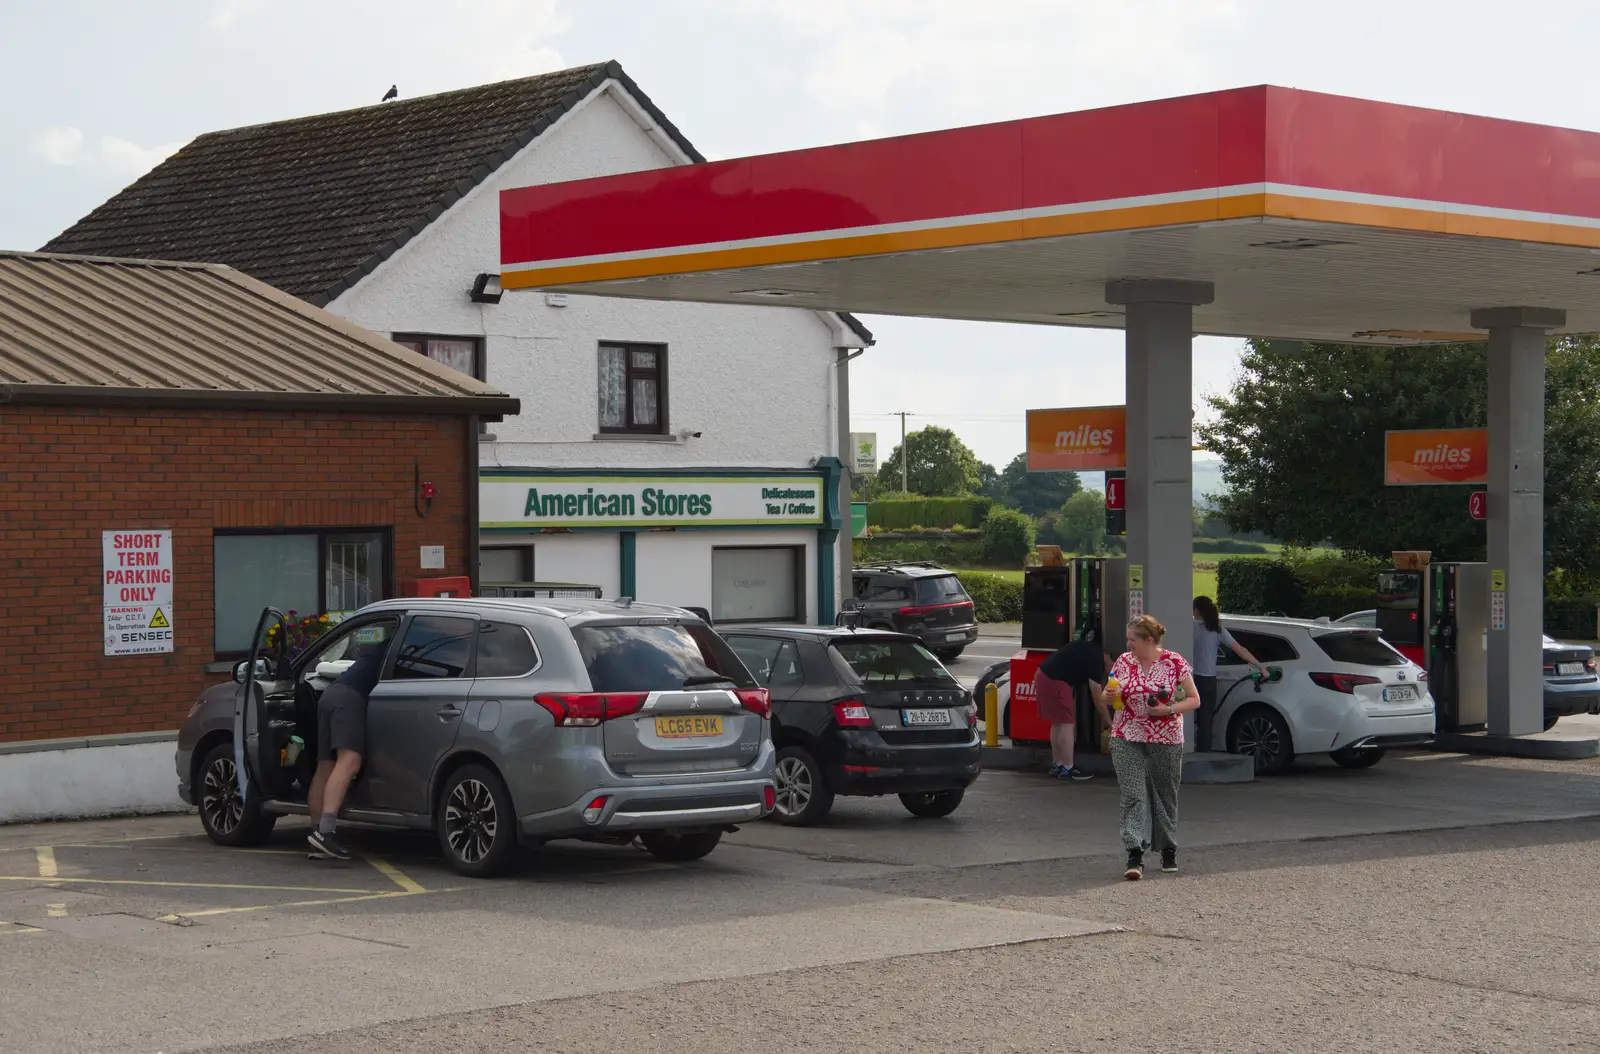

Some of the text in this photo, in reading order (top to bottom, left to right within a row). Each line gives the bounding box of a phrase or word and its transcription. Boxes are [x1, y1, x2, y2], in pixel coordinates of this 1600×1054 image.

[1055, 425, 1113, 447] miles
[1413, 443, 1472, 463] miles
[762, 487, 815, 499] Delicatessen
[1108, 484, 1116, 505] 4
[524, 487, 712, 517] American Stores
[765, 503, 816, 515] Tea / Coffee
[1473, 496, 1480, 515] 2
[113, 533, 162, 549] SHORT
[117, 551, 159, 567] TERM
[106, 568, 171, 585] PARKING
[120, 586, 156, 602] ONLY
[116, 623, 146, 631] Operation
[121, 630, 173, 642] SENSEC
[114, 646, 165, 654] www.sensec.ie
[660, 718, 718, 734] LC65 EVK
